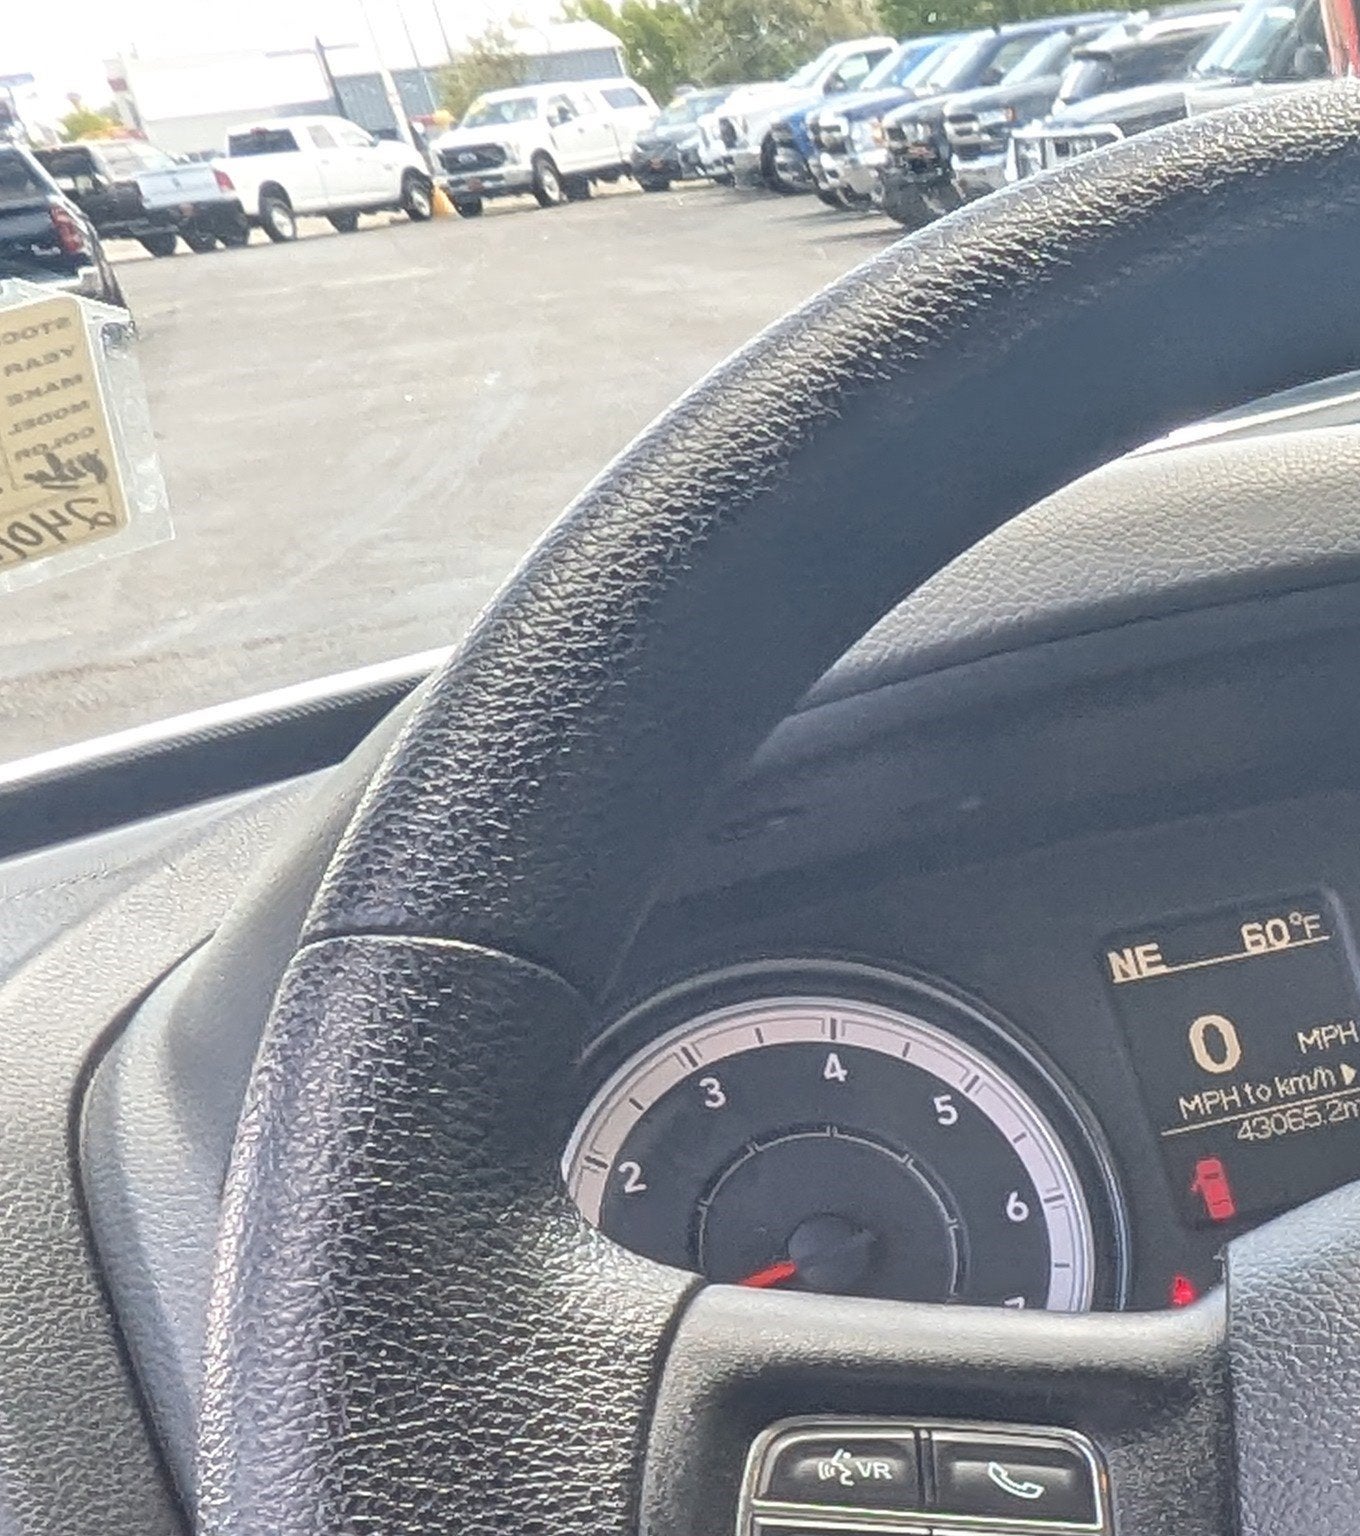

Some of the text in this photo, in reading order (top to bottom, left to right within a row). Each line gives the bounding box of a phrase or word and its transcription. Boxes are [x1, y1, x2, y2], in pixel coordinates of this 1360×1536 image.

[1107, 911, 1321, 982] NE 60°F
[1188, 1014, 1360, 1075] 0 MPH
[823, 1052, 849, 1084] 4
[699, 1076, 728, 1109] 3
[1178, 1065, 1337, 1120] MPH to km/h
[933, 1094, 960, 1126] 5
[617, 1161, 647, 1195] 2
[1006, 1191, 1030, 1223] 6
[855, 1460, 893, 1480] VR
